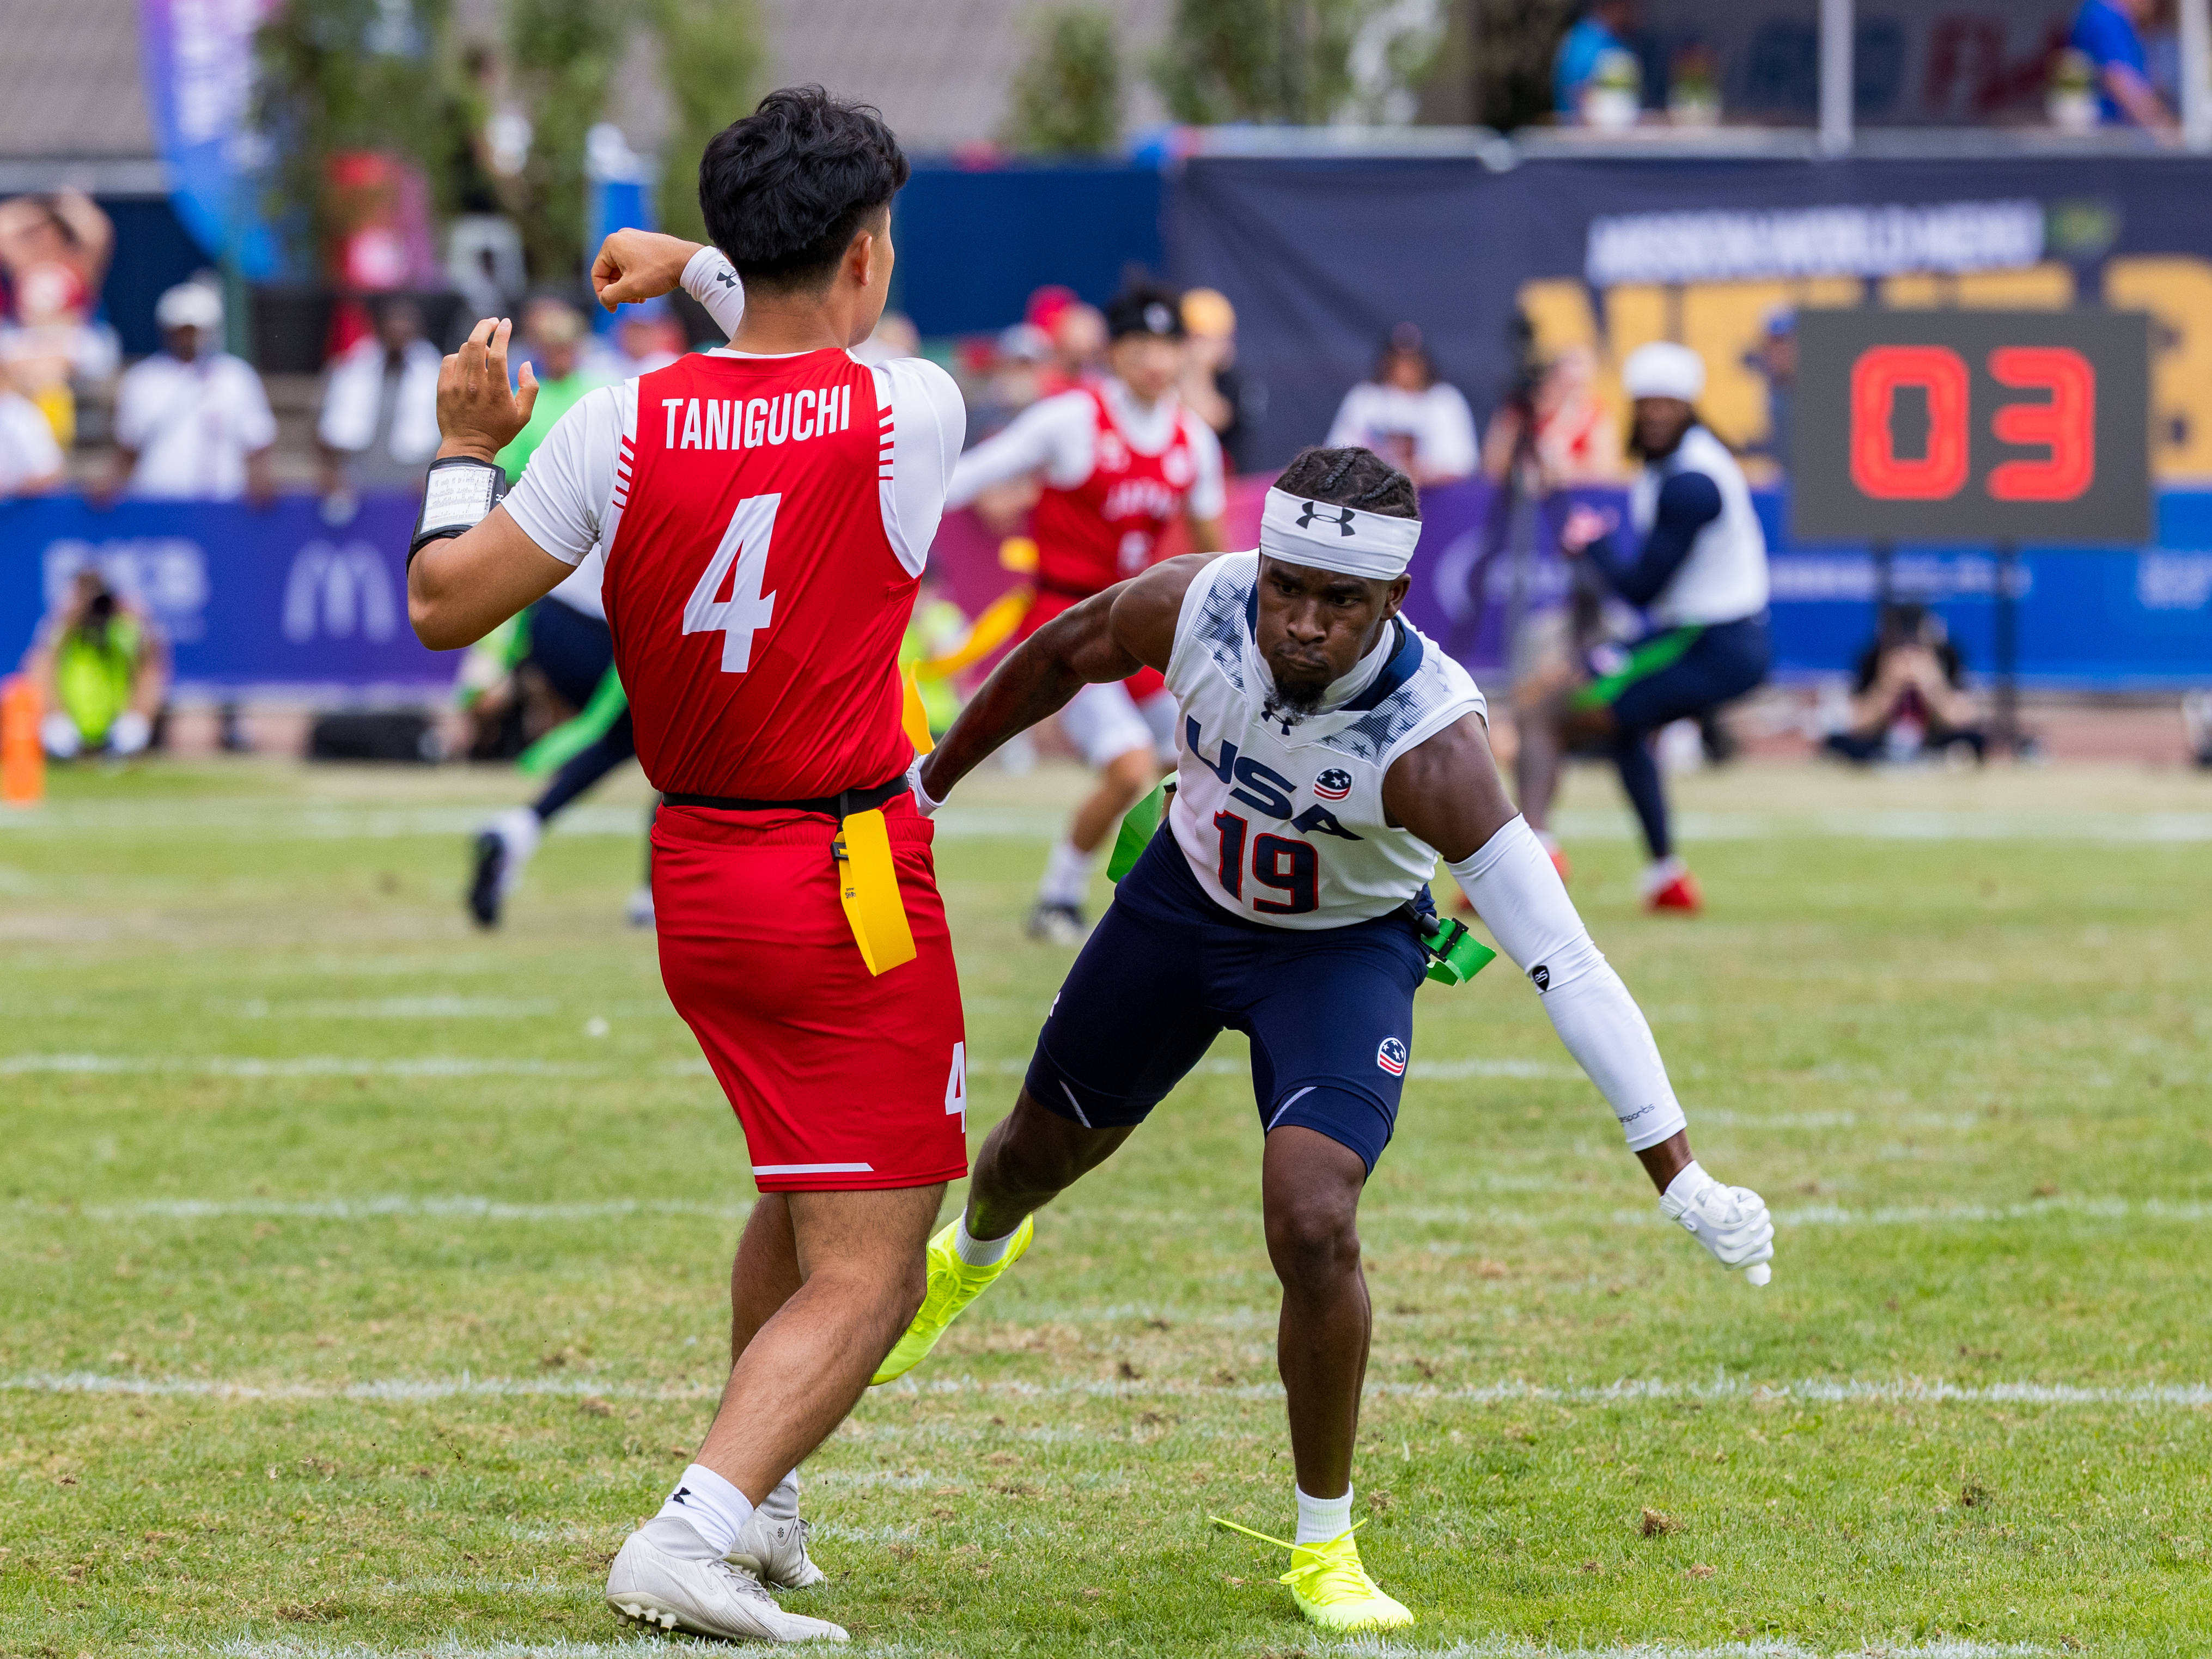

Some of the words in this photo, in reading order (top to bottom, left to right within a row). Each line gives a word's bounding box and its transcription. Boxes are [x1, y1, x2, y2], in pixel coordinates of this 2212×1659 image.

[662, 385, 850, 450] TANIGUCHI
[1850, 345, 2095, 500] 03
[682, 492, 782, 673] 4
[1186, 715, 1364, 840] USA
[1214, 810, 1319, 914] 19
